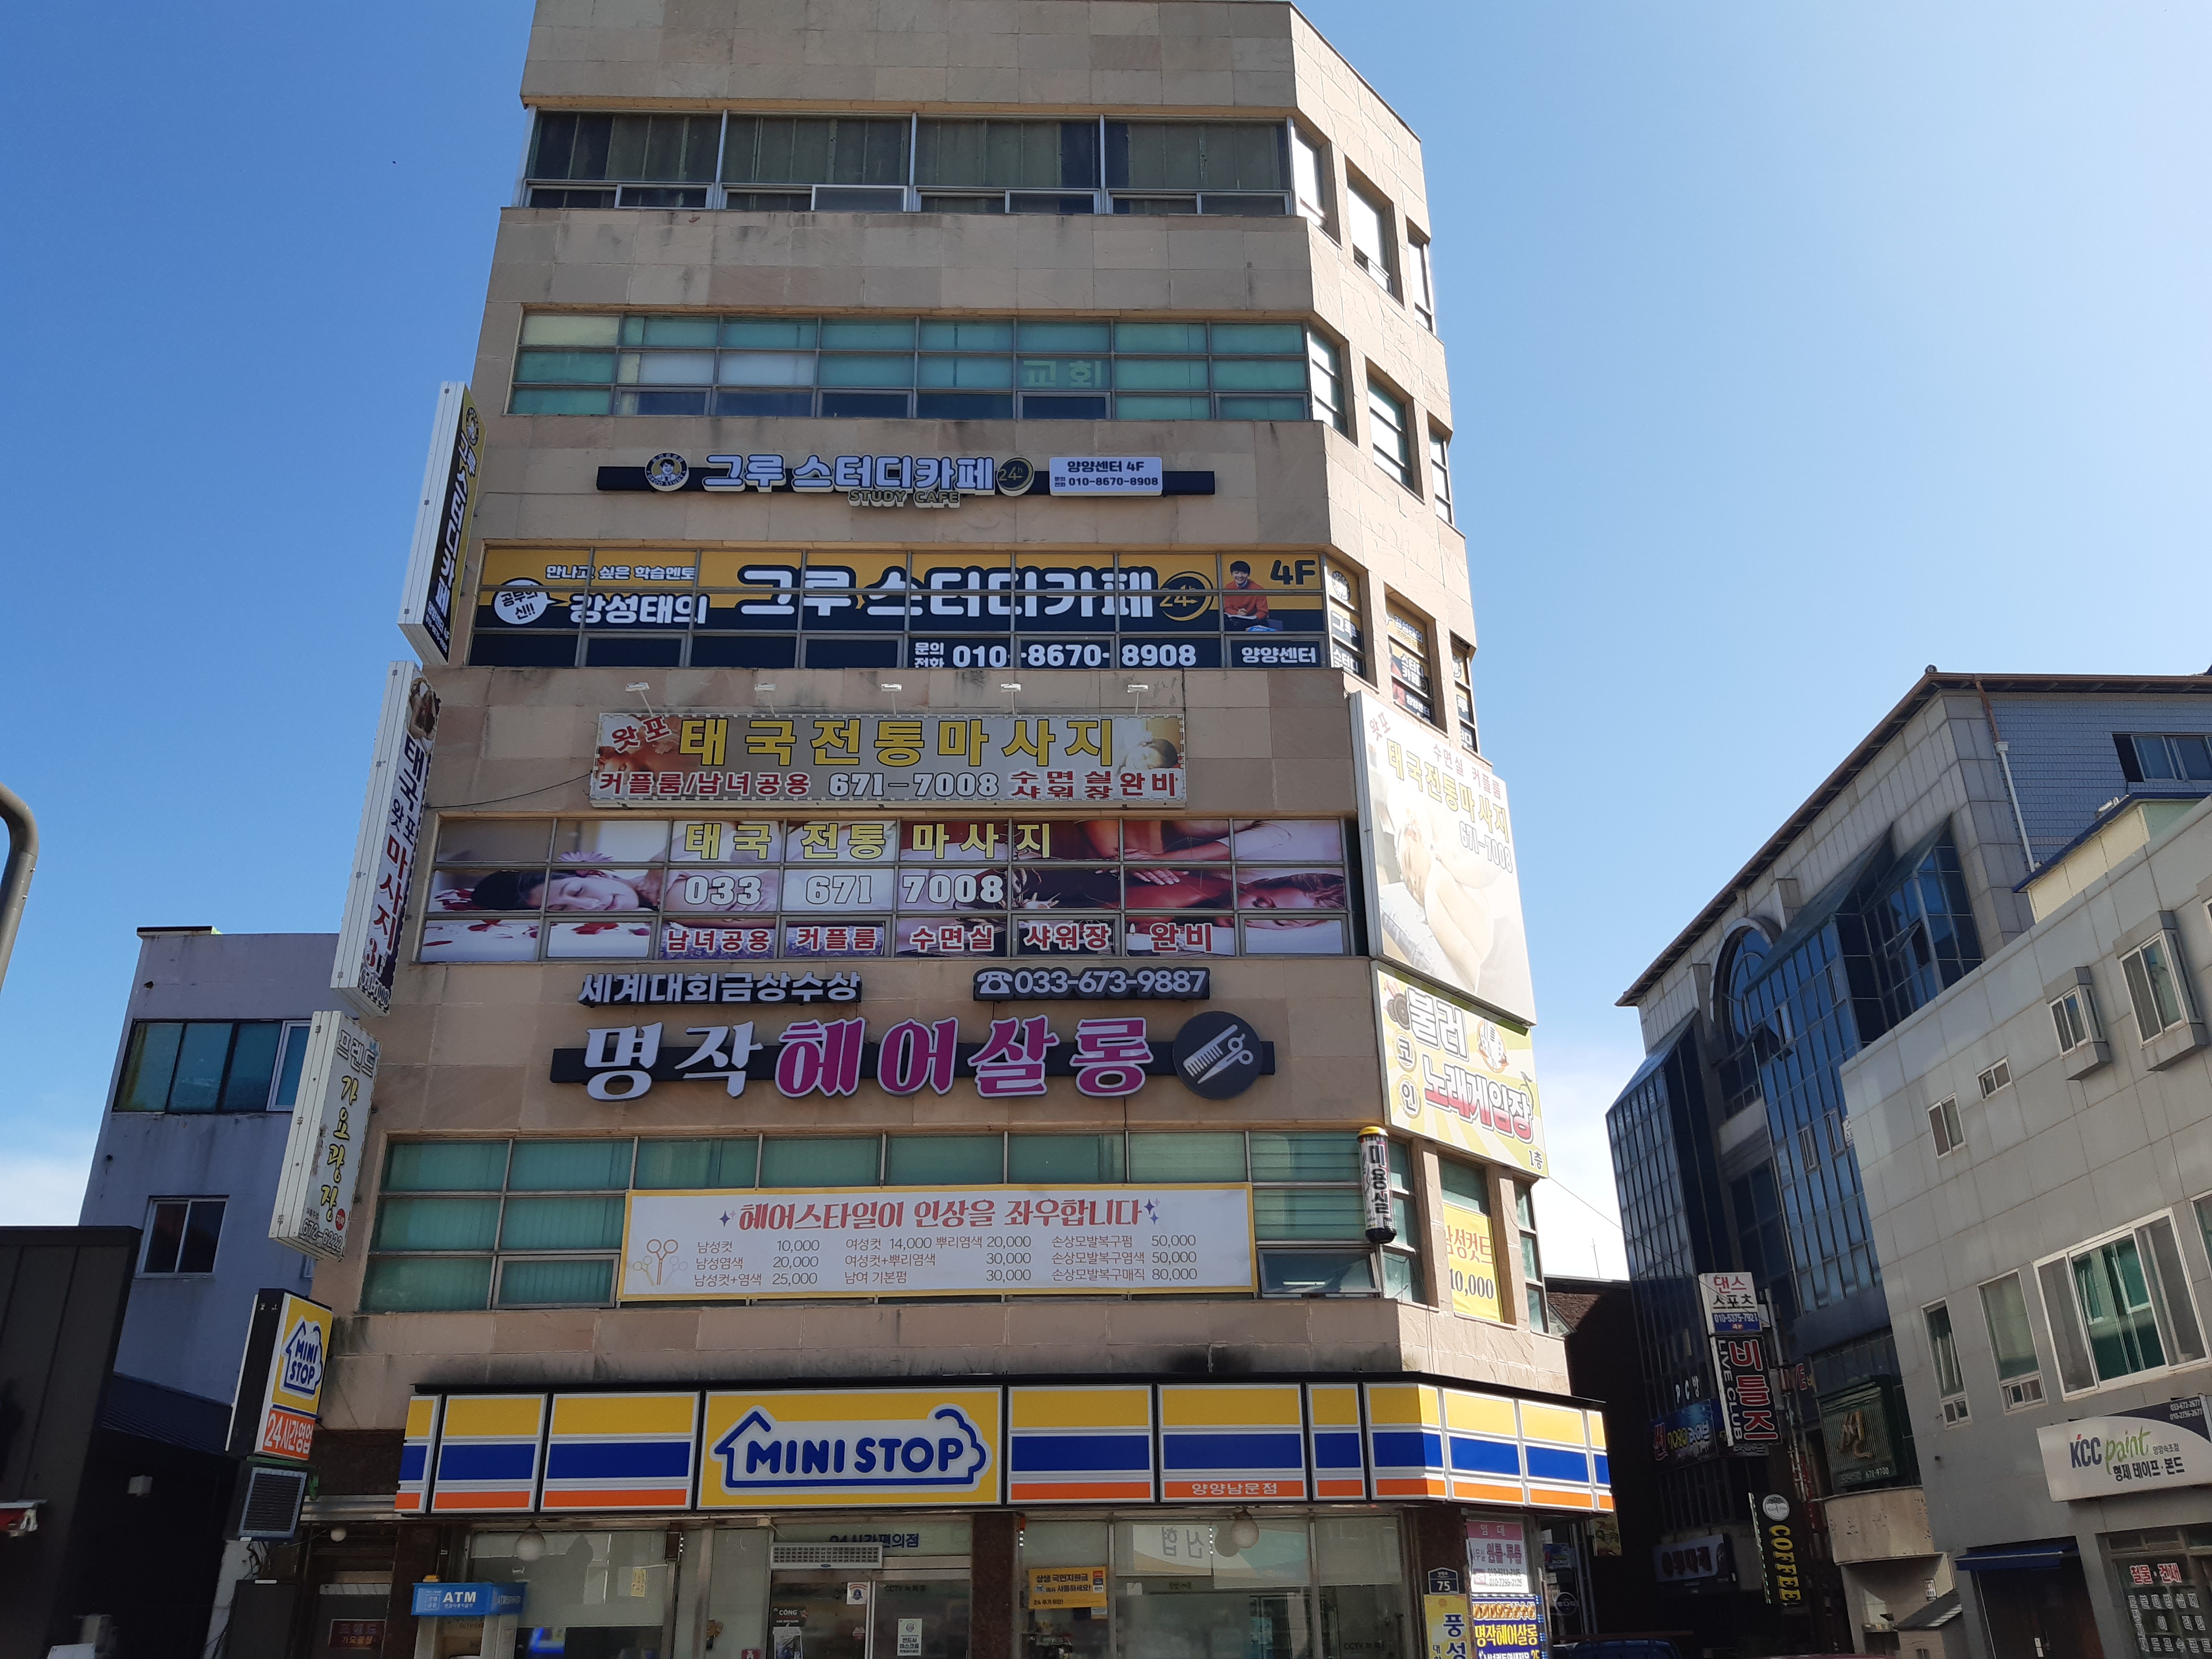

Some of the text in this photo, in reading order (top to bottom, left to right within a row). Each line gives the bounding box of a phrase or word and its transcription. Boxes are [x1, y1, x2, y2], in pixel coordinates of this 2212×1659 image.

[1022, 361, 1102, 387] 교회
[458, 432, 477, 477] 그루
[1068, 461, 1144, 473] 양양센터 4F
[703, 454, 995, 492] 그루 스터디카페
[1069, 478, 1158, 486] 010-8670-8908
[849, 490, 959, 504] STUDY CAFE
[435, 467, 468, 617] 스터디카페
[546, 565, 697, 580] 만나고 싶은 학습멘토
[1270, 560, 1315, 585] 4F
[501, 589, 538, 606] 공부의
[741, 570, 852, 616] 그루
[867, 571, 1153, 617] 스터디카페
[515, 603, 536, 620] 신!!
[570, 595, 707, 624] 강성태의
[1332, 612, 1357, 638] 그루
[914, 643, 944, 655] 문의
[1241, 647, 1316, 664] 양양센터
[1334, 649, 1358, 673] 스터디
[914, 658, 944, 668] 전화
[1401, 654, 1425, 678] 스터디
[1402, 666, 1421, 687] 카페
[1407, 695, 1430, 717] 양양센터
[611, 715, 672, 754] 왓포
[679, 718, 1112, 767] 태국전통마사지
[599, 772, 999, 797] 커플룸/남녀공용 671-7008
[1011, 770, 1179, 797] 수면실 완비
[1433, 744, 1501, 800] 수면실 커플룸
[1010, 786, 1111, 799] 샤워장
[1387, 738, 1510, 843] 태국전통마사지
[685, 822, 1050, 860] 태국 전통 마사지
[1459, 820, 1513, 873] 671-7008
[373, 834, 408, 955] 마사지
[684, 875, 1003, 905] 033 671 7008
[667, 923, 1213, 952] 남녀공용 커플룸 수면실 샤워장 완비
[366, 938, 386, 976] 3F
[361, 967, 390, 1008] 671-7008
[578, 971, 861, 1002] 세계대회금상수상
[1015, 970, 1206, 993] 033-673-9887
[337, 1029, 375, 1078] 프렌드
[584, 1014, 1154, 1100] 명작 헤어살롱
[1423, 1054, 1533, 1142] 노래게임장
[1529, 1150, 1543, 1170] 1층
[1369, 1145, 1390, 1214] 미용실
[337, 1214, 345, 1226] 지하
[739, 1198, 1142, 1230] 헤어스타일이 인상을 좌우합니다
[303, 1218, 343, 1252] 672-6222
[697, 1235, 1196, 1253] 남성컷 10,000 여성컷 14,000 뿌리염색 20,000 손상모발복구펌 50,000
[1445, 1224, 1494, 1264] 남성컷트
[696, 1251, 1197, 1270] 남성염색 20,000 여성컷+뿌리염색 30,000 손상모발복구염색 50,000
[694, 1268, 1197, 1287] 남성컷+염색 25,000 남여 기본펌 30,000 손상모발복구매직 80,000
[1449, 1268, 1494, 1299] 10,000
[1714, 1276, 1747, 1294] 댄스
[1713, 1294, 1755, 1309] 스포츠
[295, 1339, 318, 1364] MINI
[290, 1360, 315, 1385] STOP
[1718, 1340, 1743, 1440] LIVE CLUB
[264, 1413, 313, 1454] 24시간영업
[2070, 1434, 2102, 1468] KCC
[2105, 1426, 2152, 1475] paint
[2113, 1460, 2131, 1482] 형제
[1191, 1483, 1277, 1495] 양양남문점
[1768, 1525, 1801, 1601] COFFEE
[443, 1591, 476, 1603] ATM
[1437, 1581, 1450, 1591] 75
[1475, 1623, 1538, 1647] 명작헤어살롱
